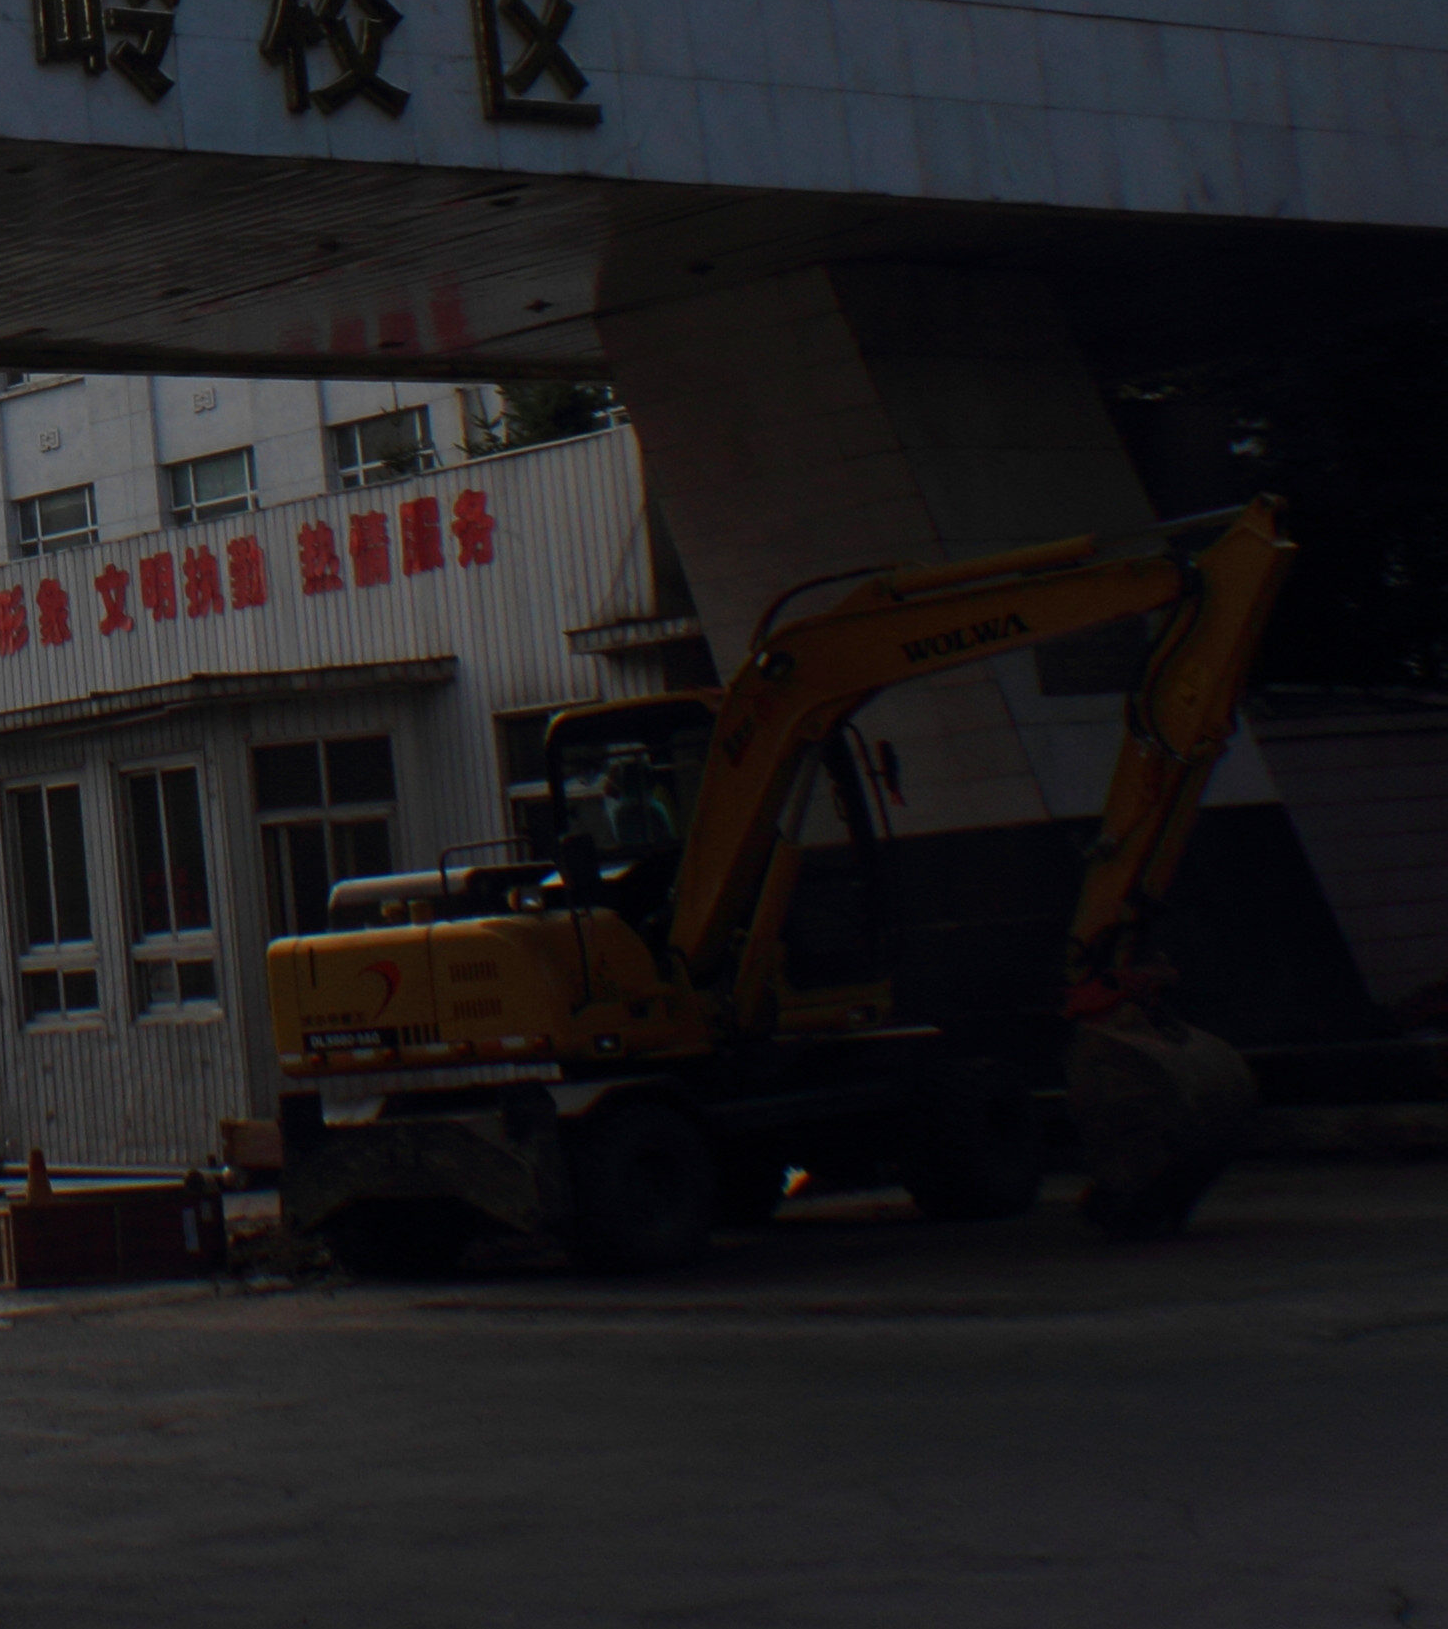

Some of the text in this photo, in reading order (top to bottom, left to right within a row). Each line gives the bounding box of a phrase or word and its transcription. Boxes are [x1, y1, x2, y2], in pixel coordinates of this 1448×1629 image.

[94, 535, 267, 637] 文明执勤
[298, 489, 495, 596] 热情服务
[901, 613, 1029, 662] WOLWA
